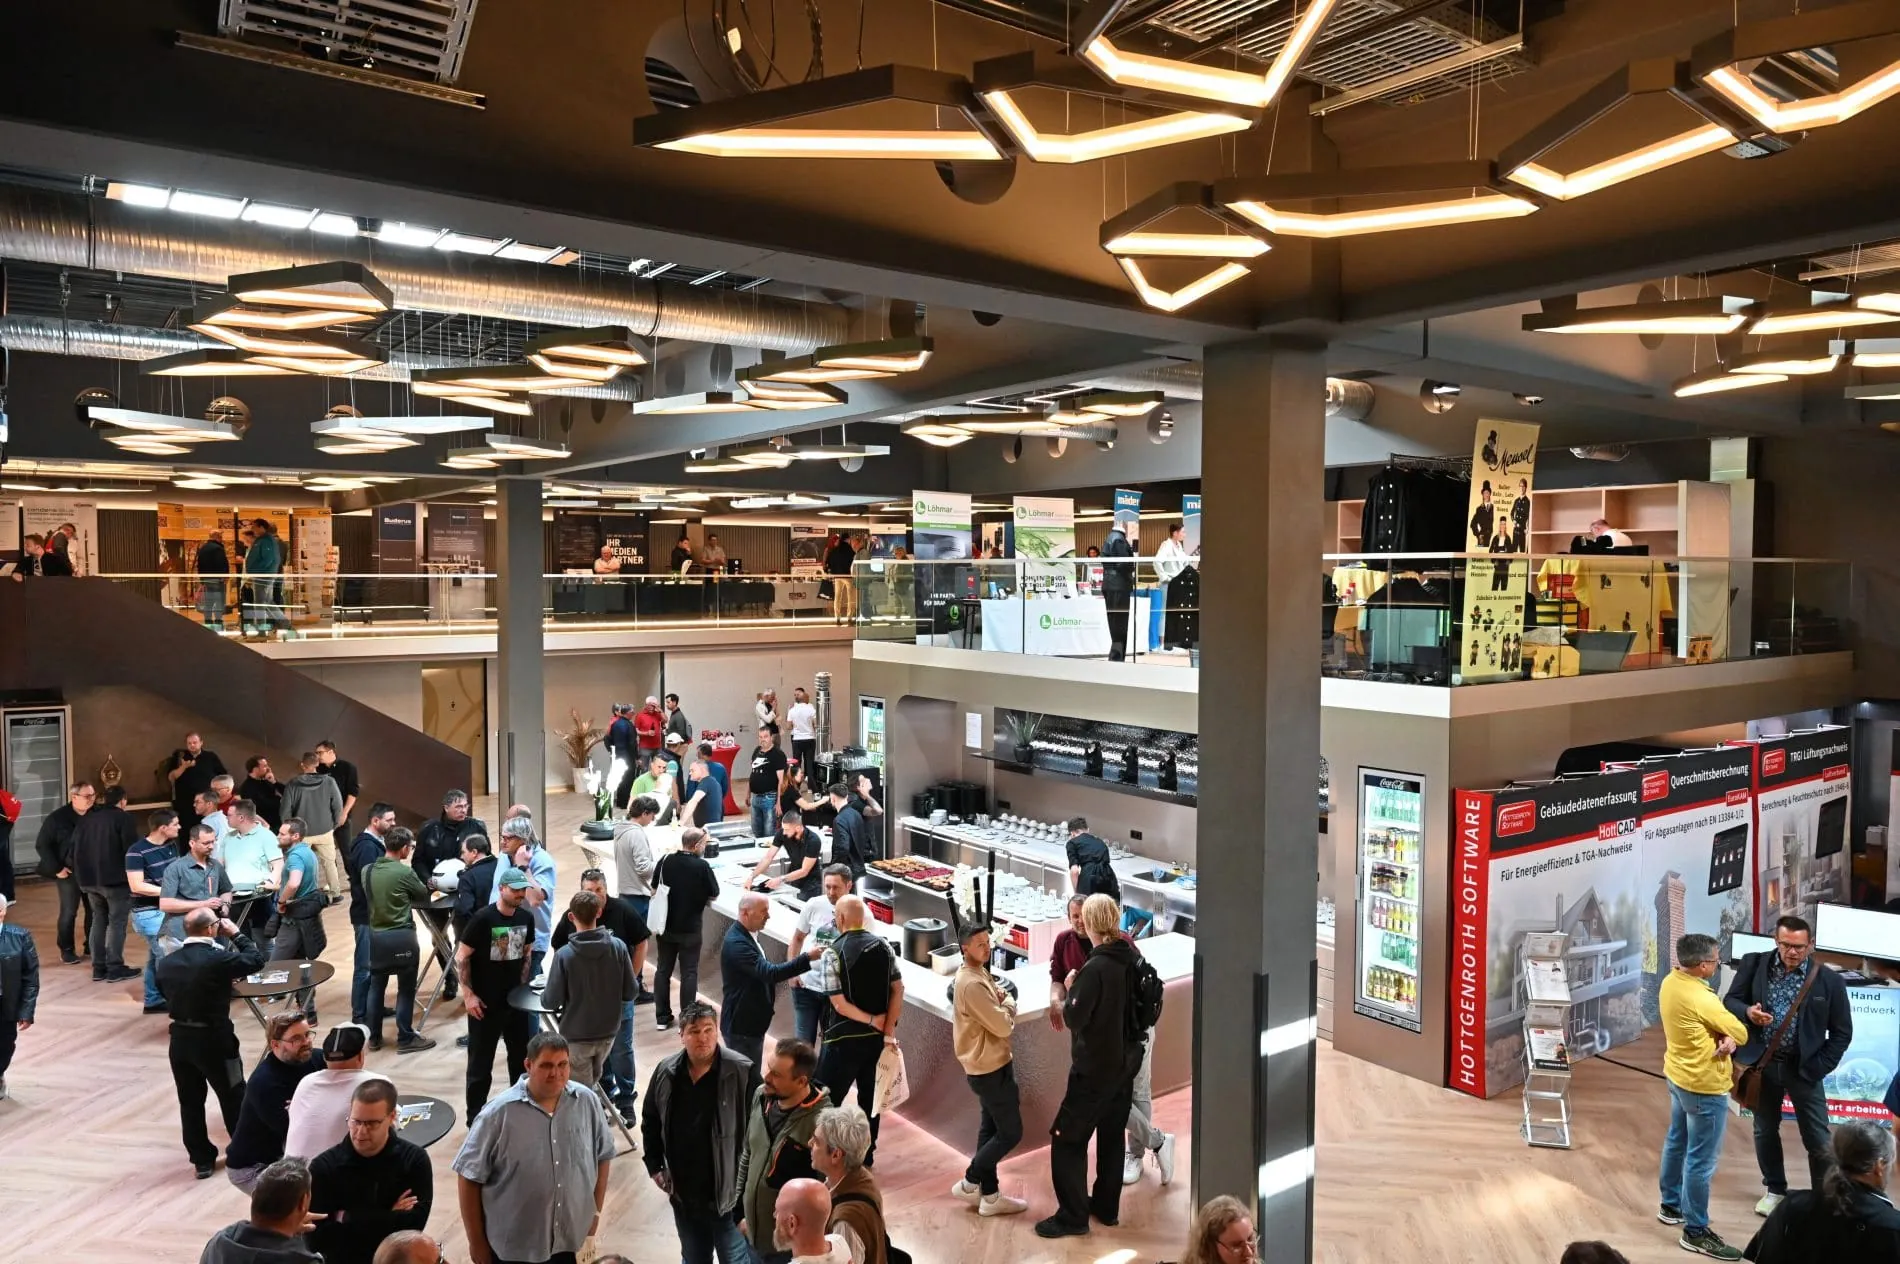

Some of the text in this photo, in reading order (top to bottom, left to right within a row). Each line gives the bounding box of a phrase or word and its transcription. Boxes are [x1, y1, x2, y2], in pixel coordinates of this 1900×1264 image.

[928, 504, 952, 513] Löhmar
[1053, 617, 1081, 626] Löhmar
[1790, 743, 1848, 762] TRGI Lüftungsnachweis
[1380, 778, 1404, 790] Coca-Cola
[1670, 764, 1748, 789] Querschnittsberechnung
[1540, 790, 1637, 819] Gebäudedatenerfassung
[1762, 798, 1787, 812] Berechnung
[1792, 789, 1823, 803] Feuchteschutz
[1824, 786, 1834, 794] nach
[1644, 809, 1744, 840] Für Abgasanlagen nach EN 13384-1/2
[1463, 798, 1481, 916] SOFTWARE
[1501, 842, 1633, 882] Für Energieeffizienz & TGA-Nachweise
[1460, 924, 1476, 1086] HOTTGENROTH
[1852, 991, 1880, 1001] Hand
[1845, 1104, 1889, 1114] arbeiten
